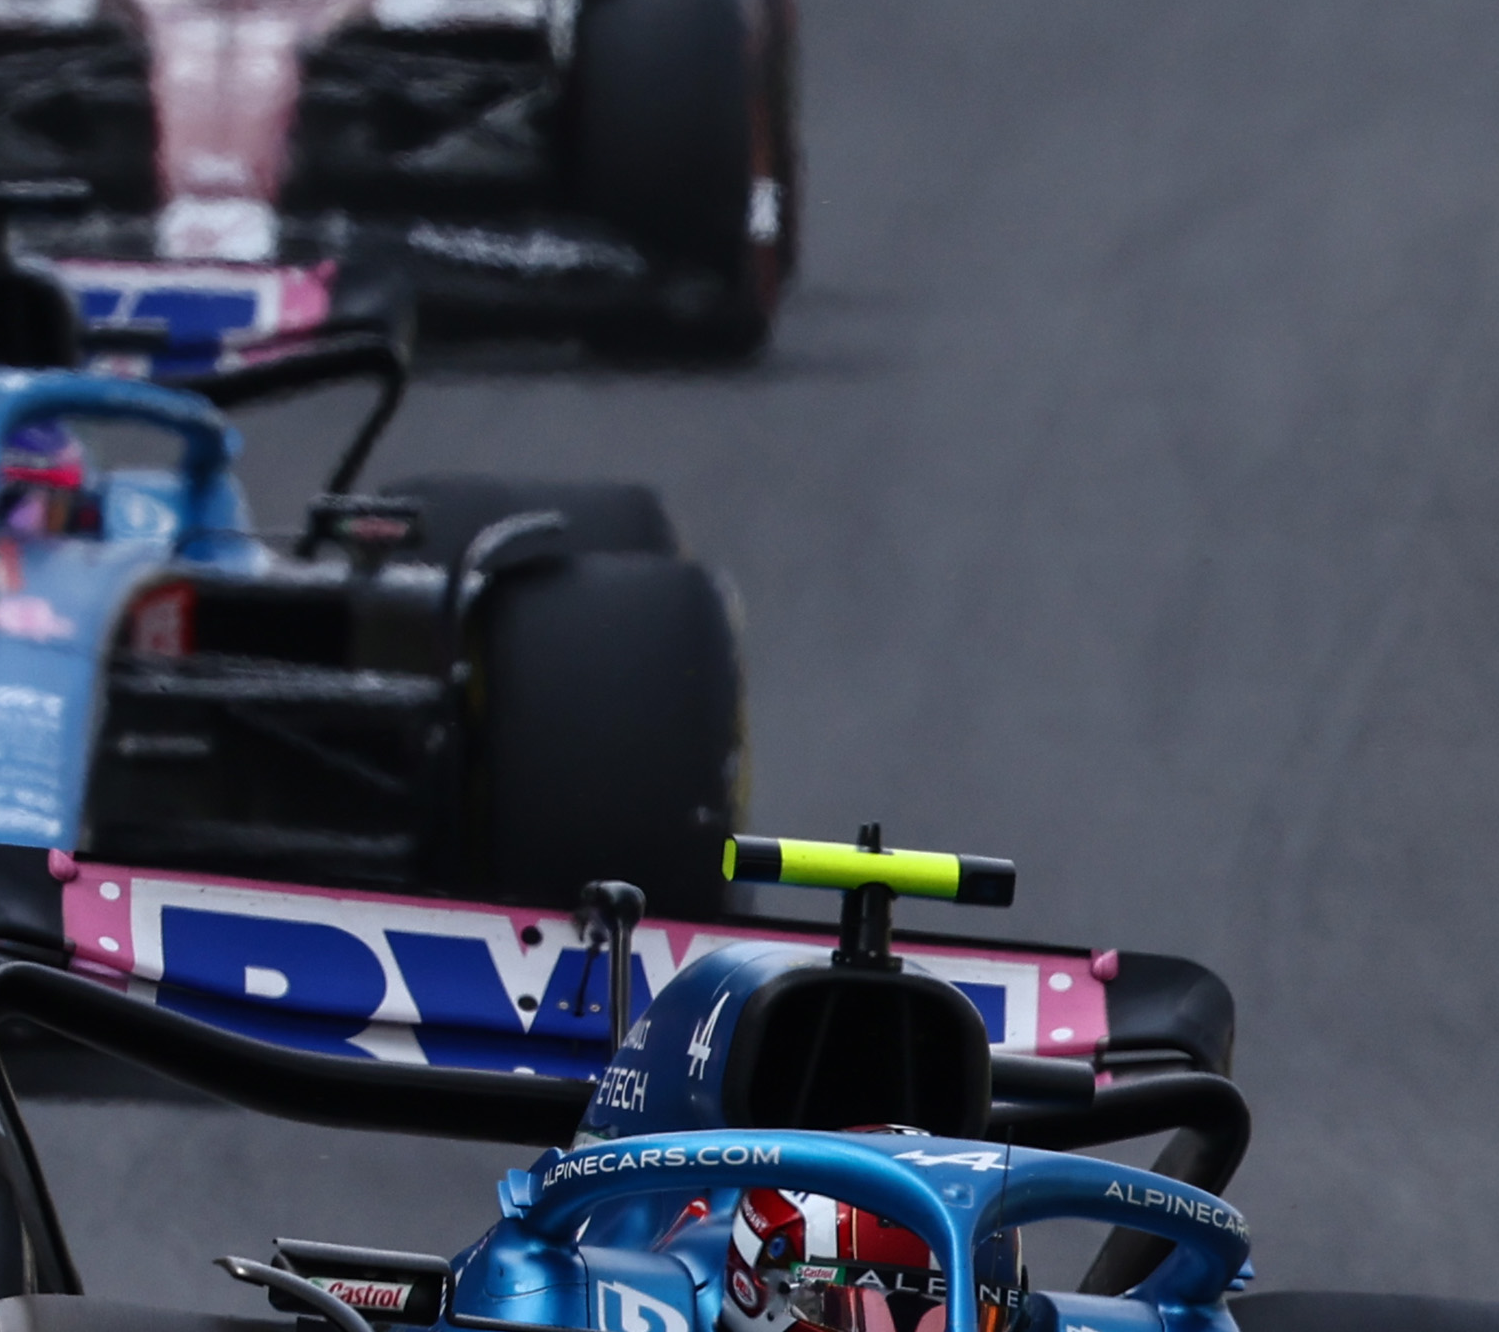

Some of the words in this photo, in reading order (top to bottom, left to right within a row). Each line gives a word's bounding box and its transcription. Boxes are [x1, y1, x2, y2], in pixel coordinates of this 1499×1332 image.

[542, 1146, 781, 1191] ALPINECARS.COM
[329, 1281, 404, 1307] Castrol
[854, 1269, 1019, 1308] ALPNE
